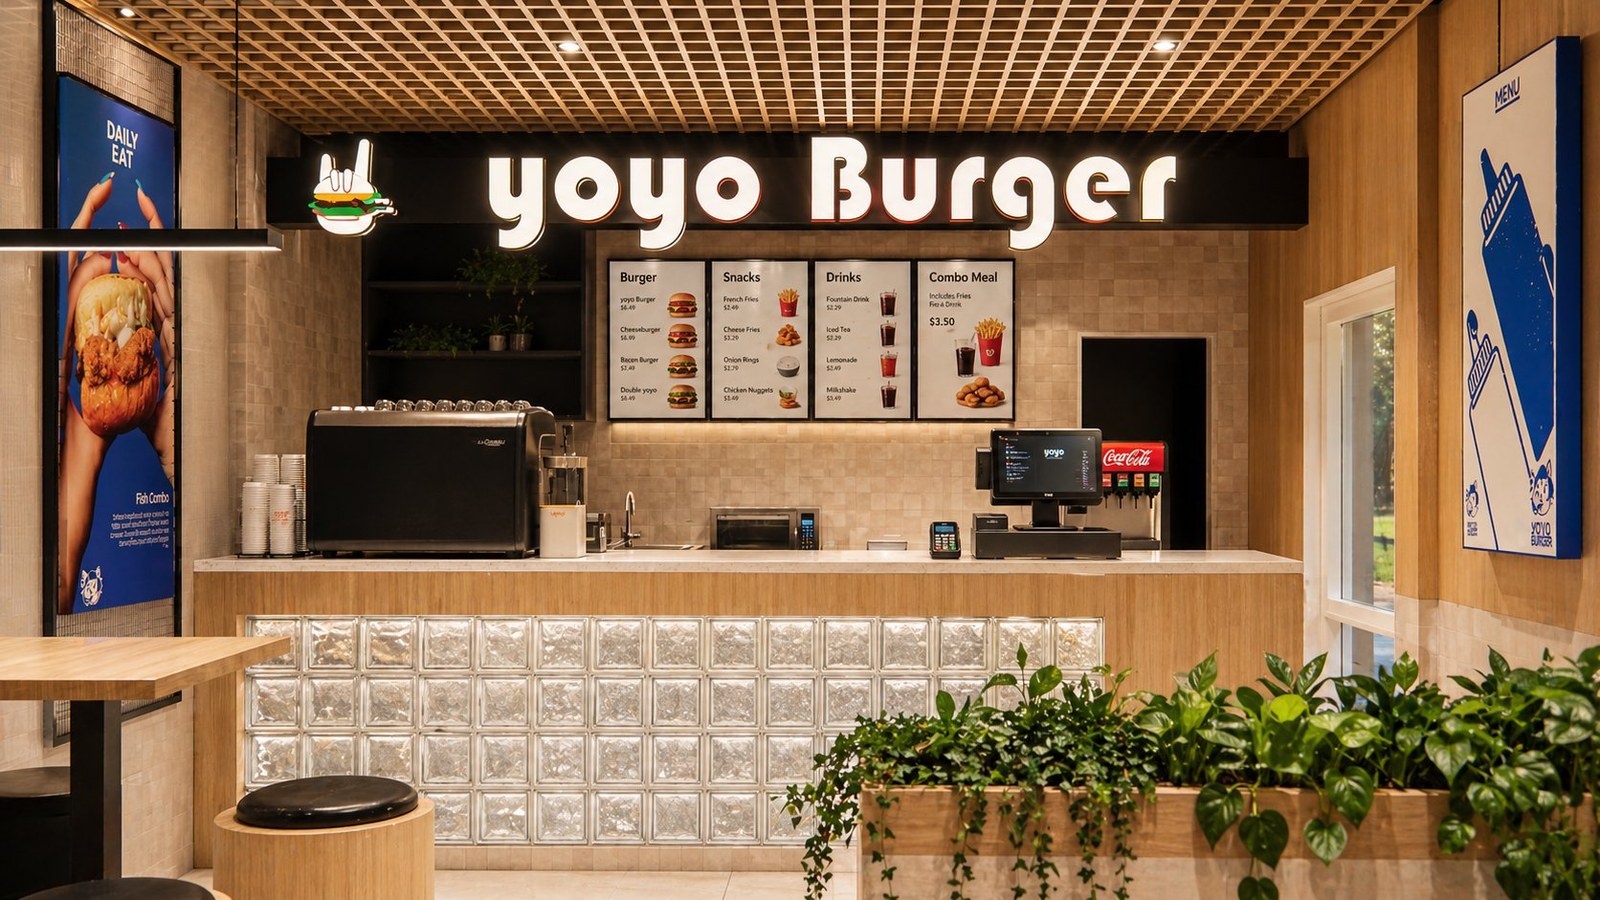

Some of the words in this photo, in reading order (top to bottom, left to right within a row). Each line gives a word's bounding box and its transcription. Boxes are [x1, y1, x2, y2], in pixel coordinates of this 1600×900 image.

[1495, 76, 1520, 108] MENU
[107, 119, 138, 150] DAILY
[112, 143, 134, 169] EAT
[488, 156, 763, 251] yoyo
[810, 136, 1177, 251] Burger
[620, 271, 657, 285] Burger
[723, 271, 761, 283] Snacks
[826, 271, 862, 283] Drinks
[929, 271, 969, 283] Combo
[971, 271, 998, 283] Meal
[620, 296, 635, 304] yoyo
[636, 296, 656, 304] Burger
[929, 292, 955, 300] Includes
[929, 316, 955, 327] $3.50
[620, 326, 661, 334] Cheeseburger
[639, 356, 659, 364] Burger
[742, 356, 760, 364] Rings
[748, 386, 774, 395] Nuggets
[1044, 448, 1065, 458] yoyo
[1103, 449, 1152, 466] Coca-Cola
[136, 492, 149, 505] Fish
[149, 491, 170, 504] Combo
[1530, 521, 1552, 536] YOYO
[1530, 535, 1553, 548] BURGER
